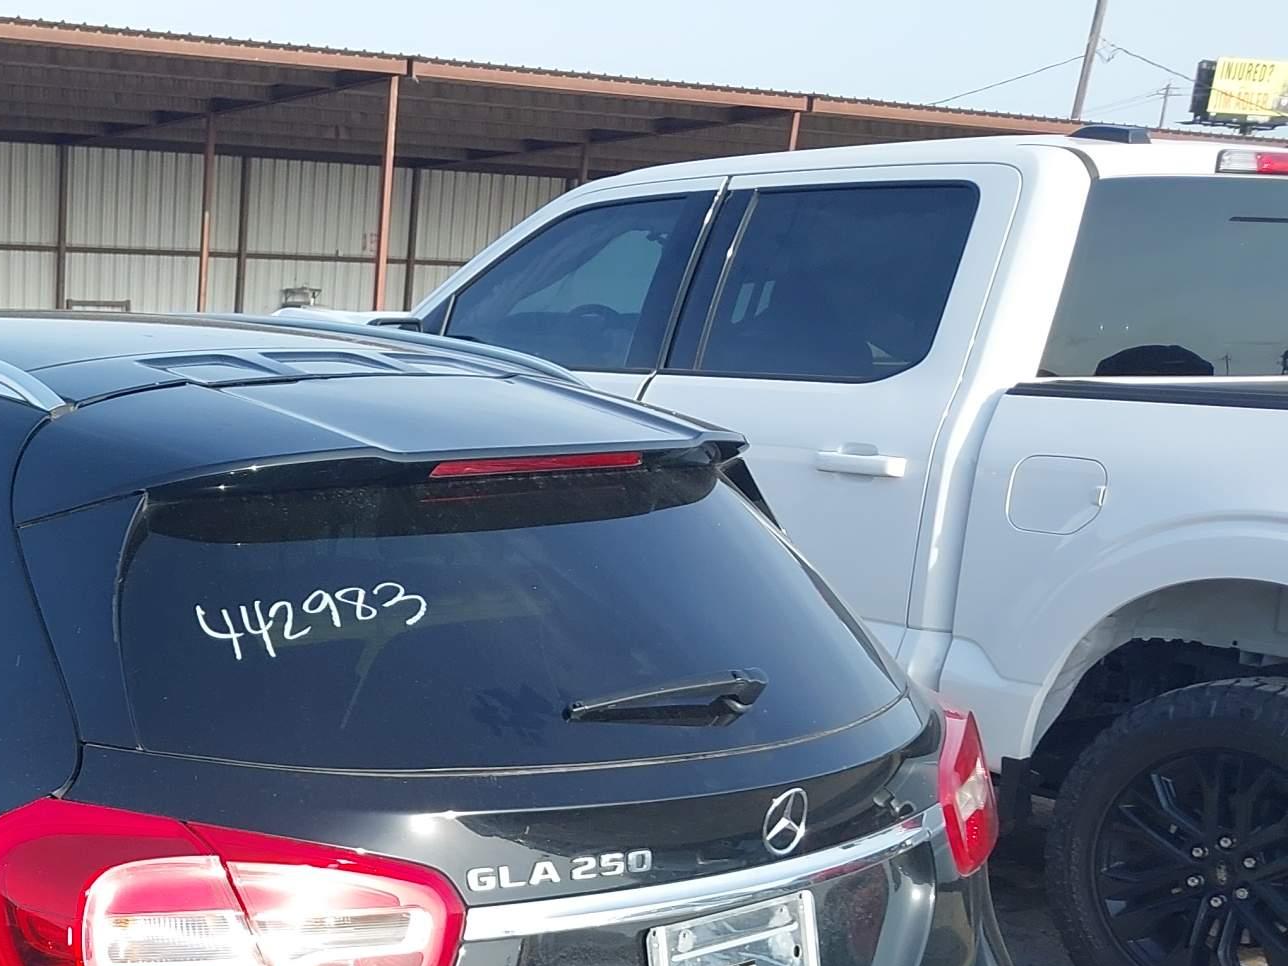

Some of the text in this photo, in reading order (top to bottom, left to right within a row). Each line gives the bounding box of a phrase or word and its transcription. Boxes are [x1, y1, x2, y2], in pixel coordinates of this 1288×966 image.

[1219, 61, 1275, 83] INJURED?
[195, 582, 427, 661] 442983
[467, 849, 653, 892] GLA 250
